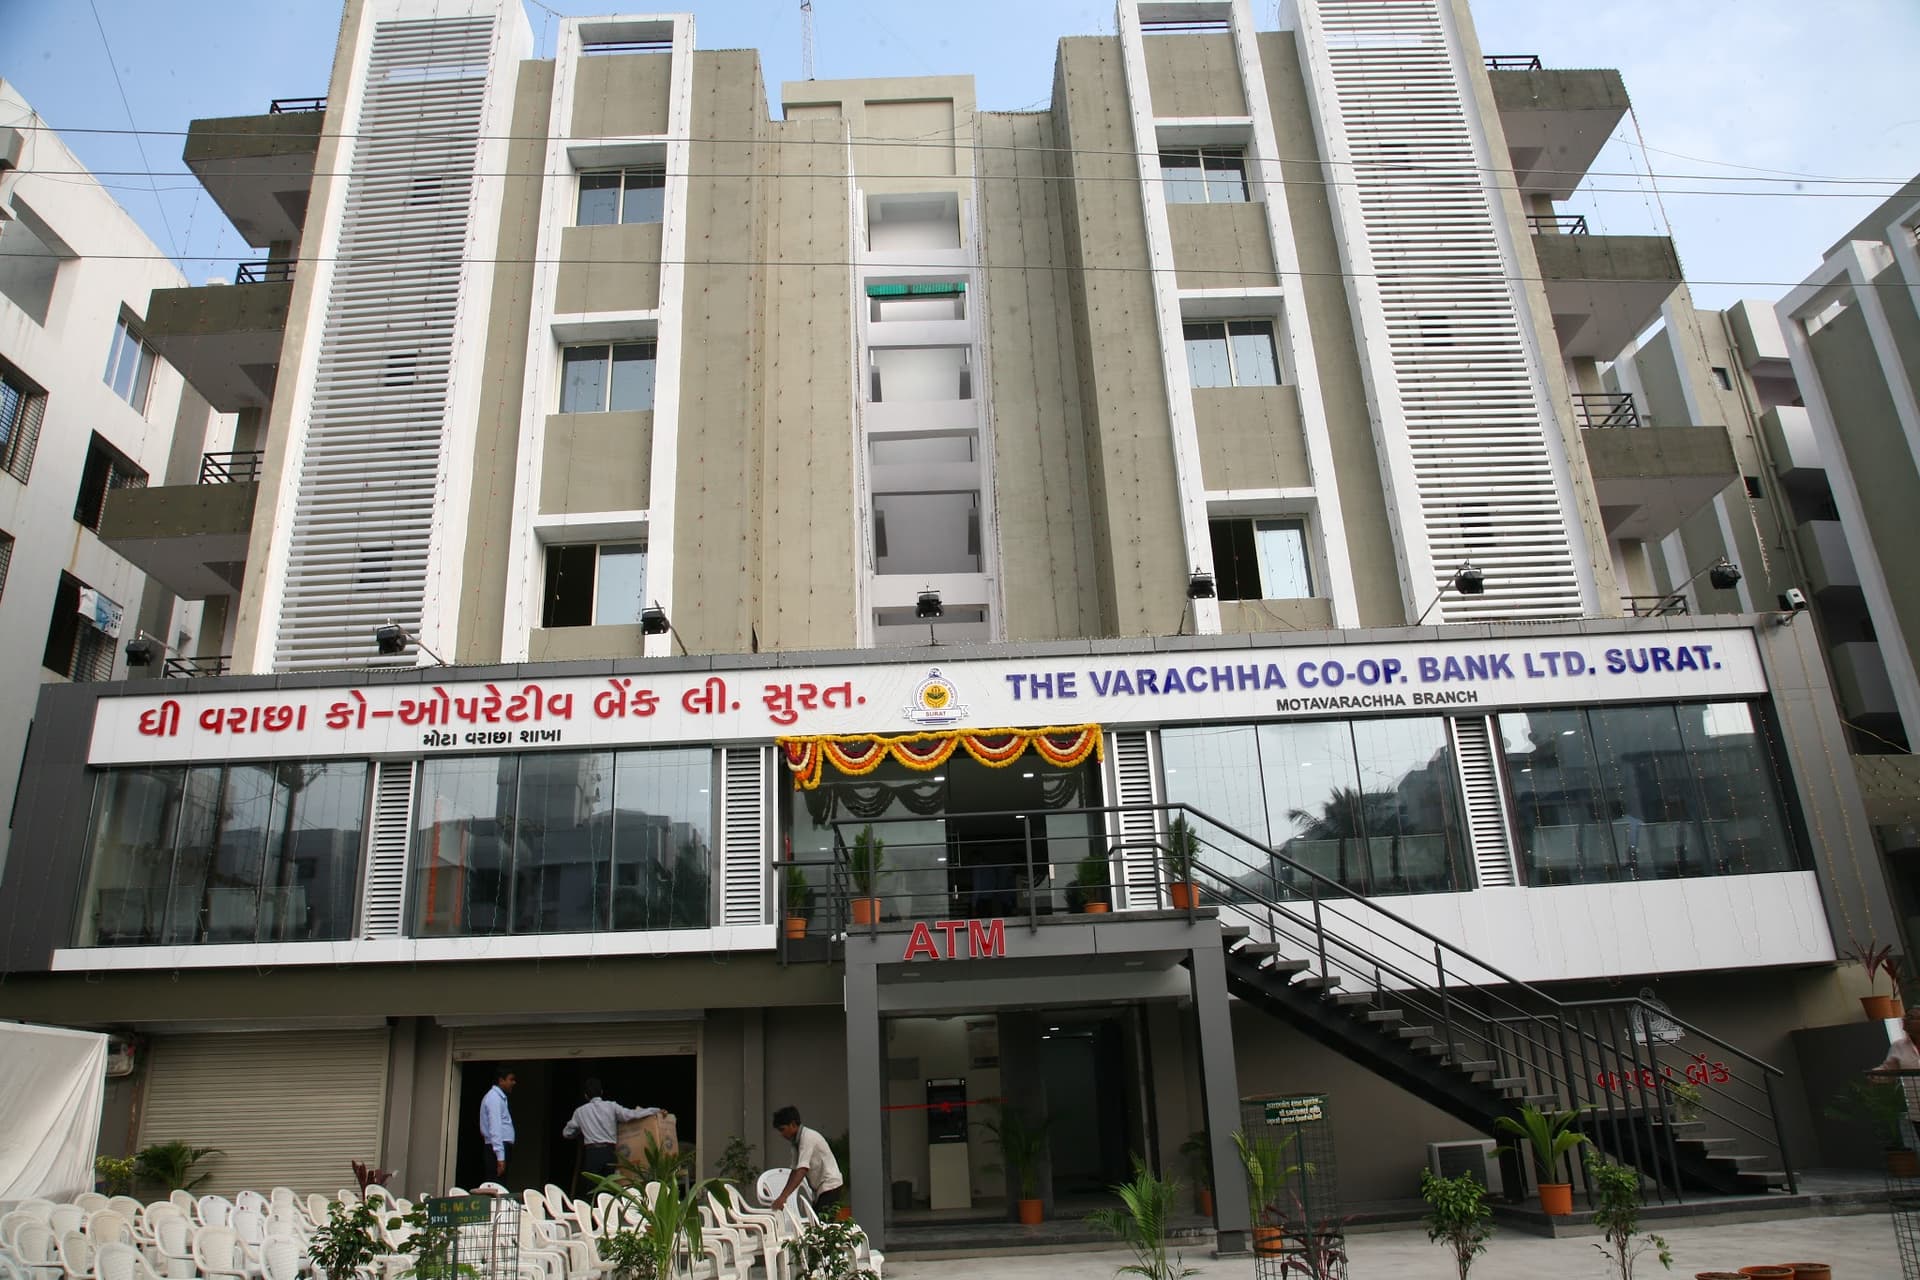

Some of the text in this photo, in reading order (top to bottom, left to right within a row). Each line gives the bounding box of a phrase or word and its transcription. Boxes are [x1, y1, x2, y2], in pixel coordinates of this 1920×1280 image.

[1006, 645, 1722, 700] THE VARACHHA CO-OP. BANK LTD. SURAT.
[199, 704, 307, 734] વરાછા
[593, 678, 660, 719] બેંક
[682, 677, 741, 715] લી.
[762, 680, 867, 725] સુરત.
[1276, 691, 1478, 712] MOTAVARACHHA BRANCH
[423, 729, 562, 746] મોટા વરાછા શાખા
[904, 918, 1006, 960] ATM
